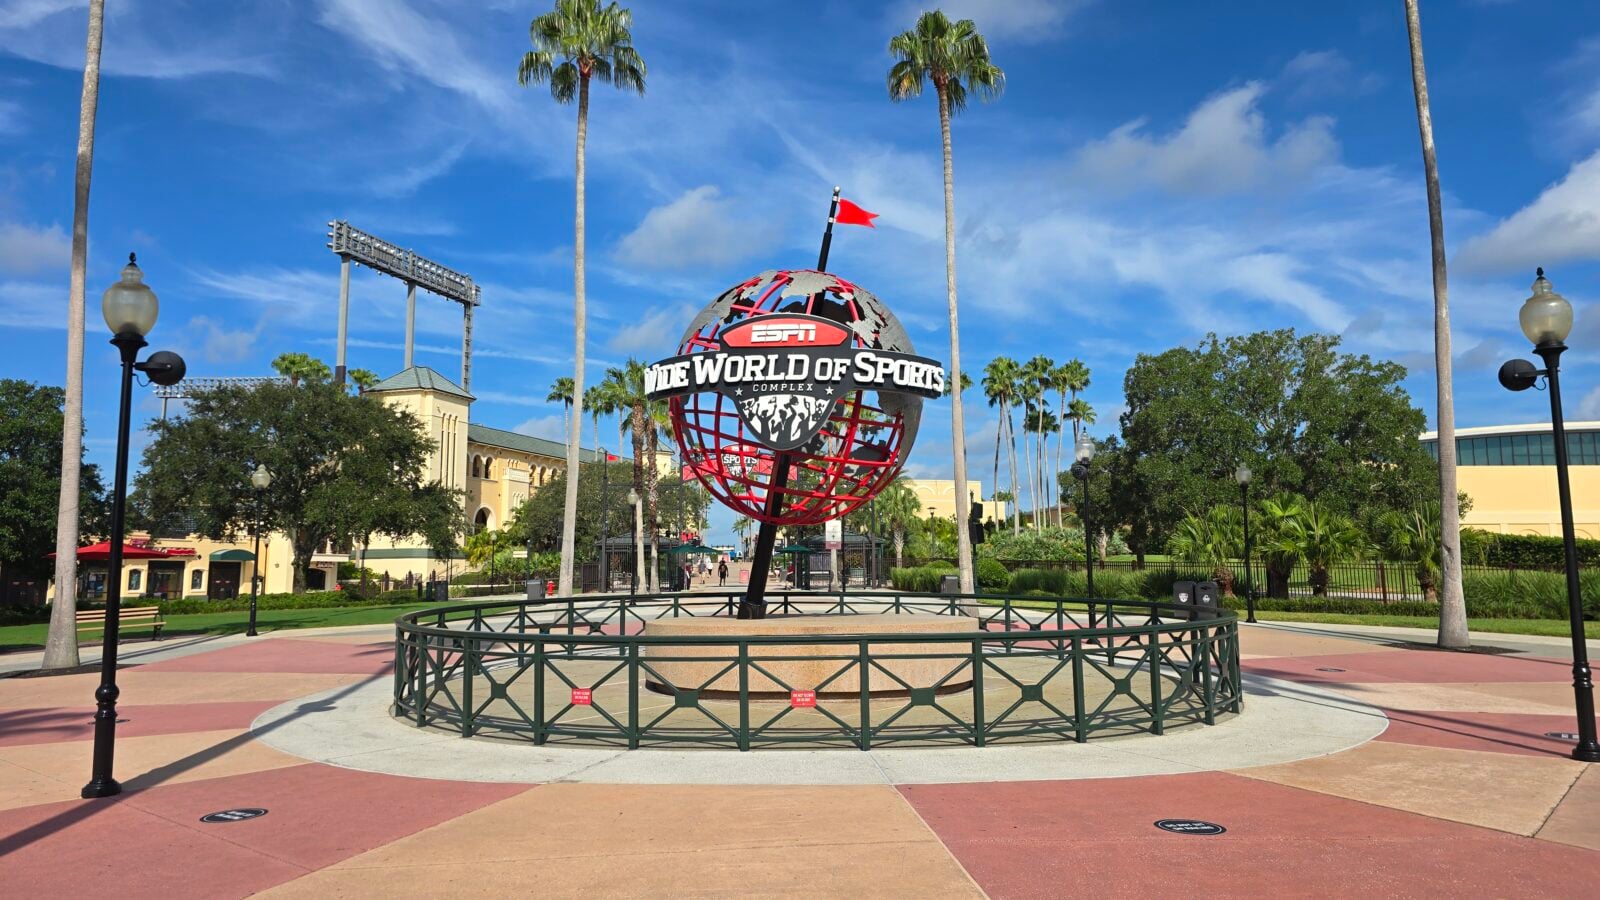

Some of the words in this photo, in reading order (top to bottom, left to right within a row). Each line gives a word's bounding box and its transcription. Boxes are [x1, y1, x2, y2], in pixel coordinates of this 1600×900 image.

[751, 323, 816, 342] ESPN
[644, 361, 690, 395] WIDE
[692, 353, 810, 385] WORLD
[814, 357, 851, 381] OF
[853, 352, 944, 392] SPORTS
[752, 383, 813, 392] COMPLEX
[723, 455, 757, 464] SPOTS
